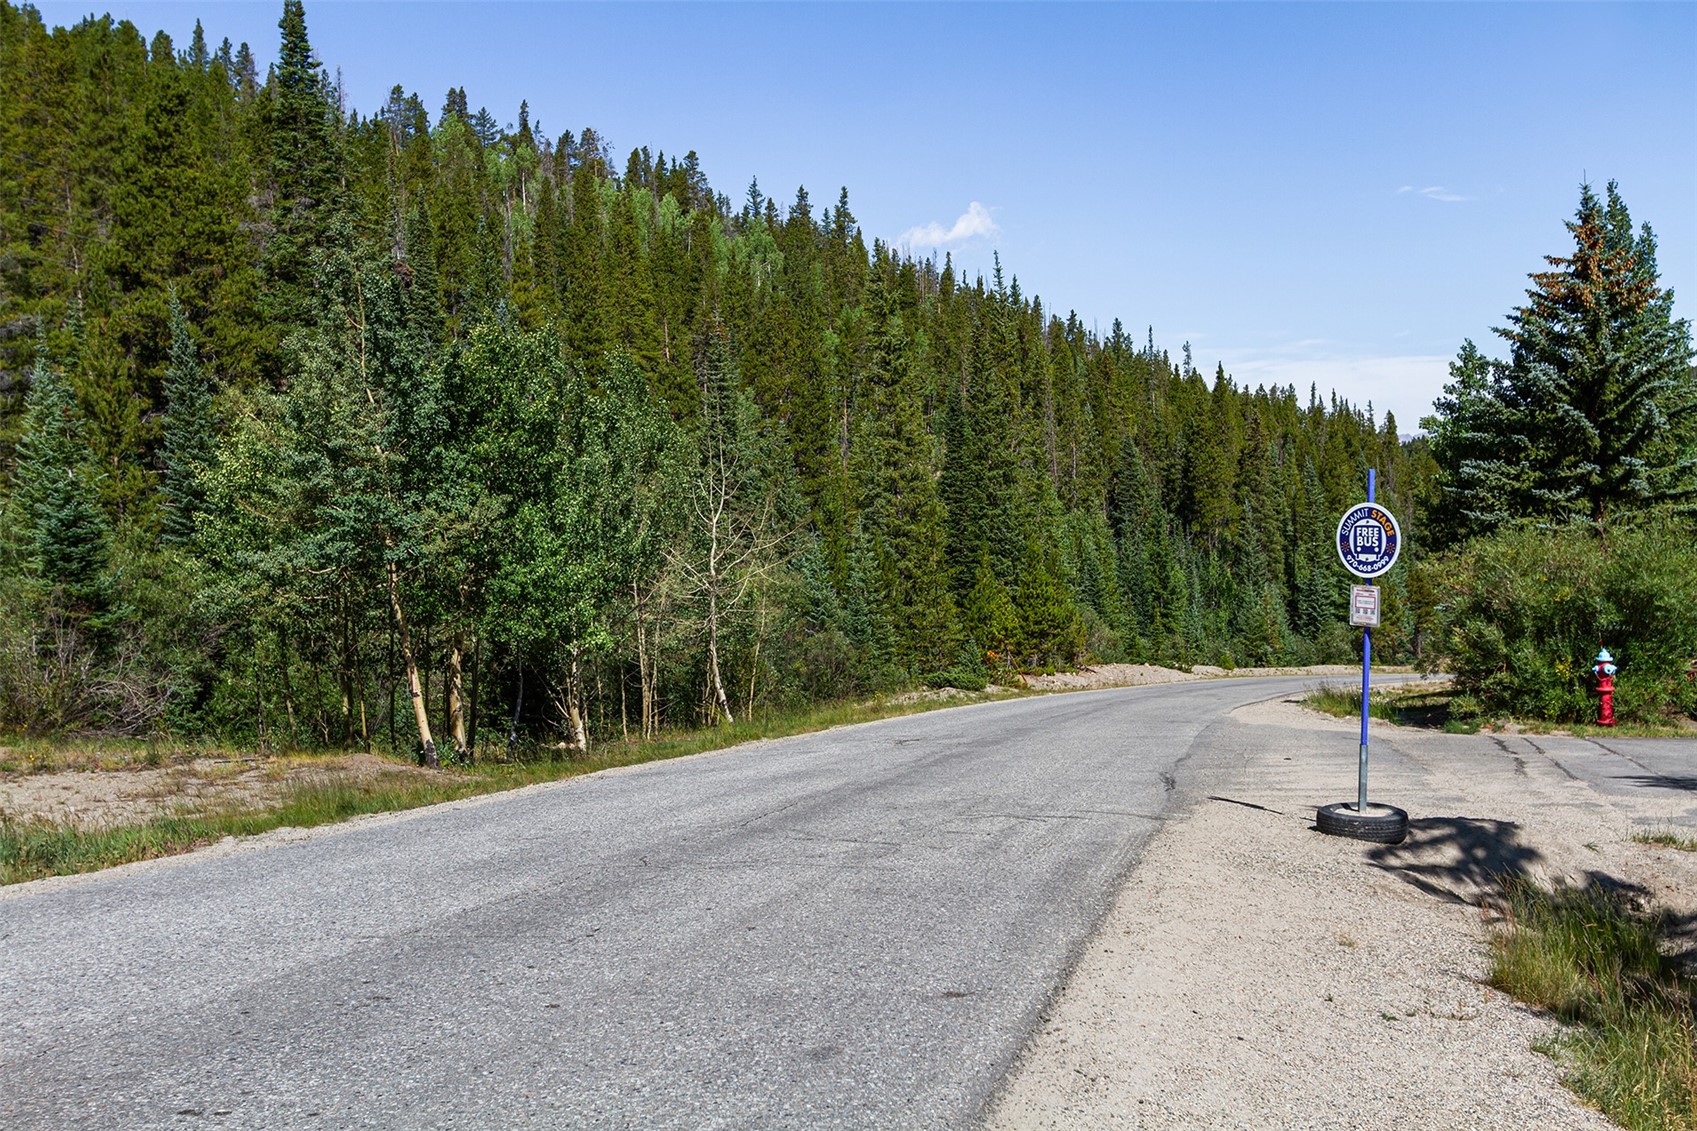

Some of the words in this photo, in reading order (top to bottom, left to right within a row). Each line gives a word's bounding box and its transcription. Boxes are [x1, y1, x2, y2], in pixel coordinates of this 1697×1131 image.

[1342, 508, 1368, 536] SUMMIT
[1371, 510, 1394, 536] STAGE
[1356, 527, 1379, 536] FREE
[1357, 536, 1379, 546] BUS
[1346, 555, 1389, 572] 970-668-0999
